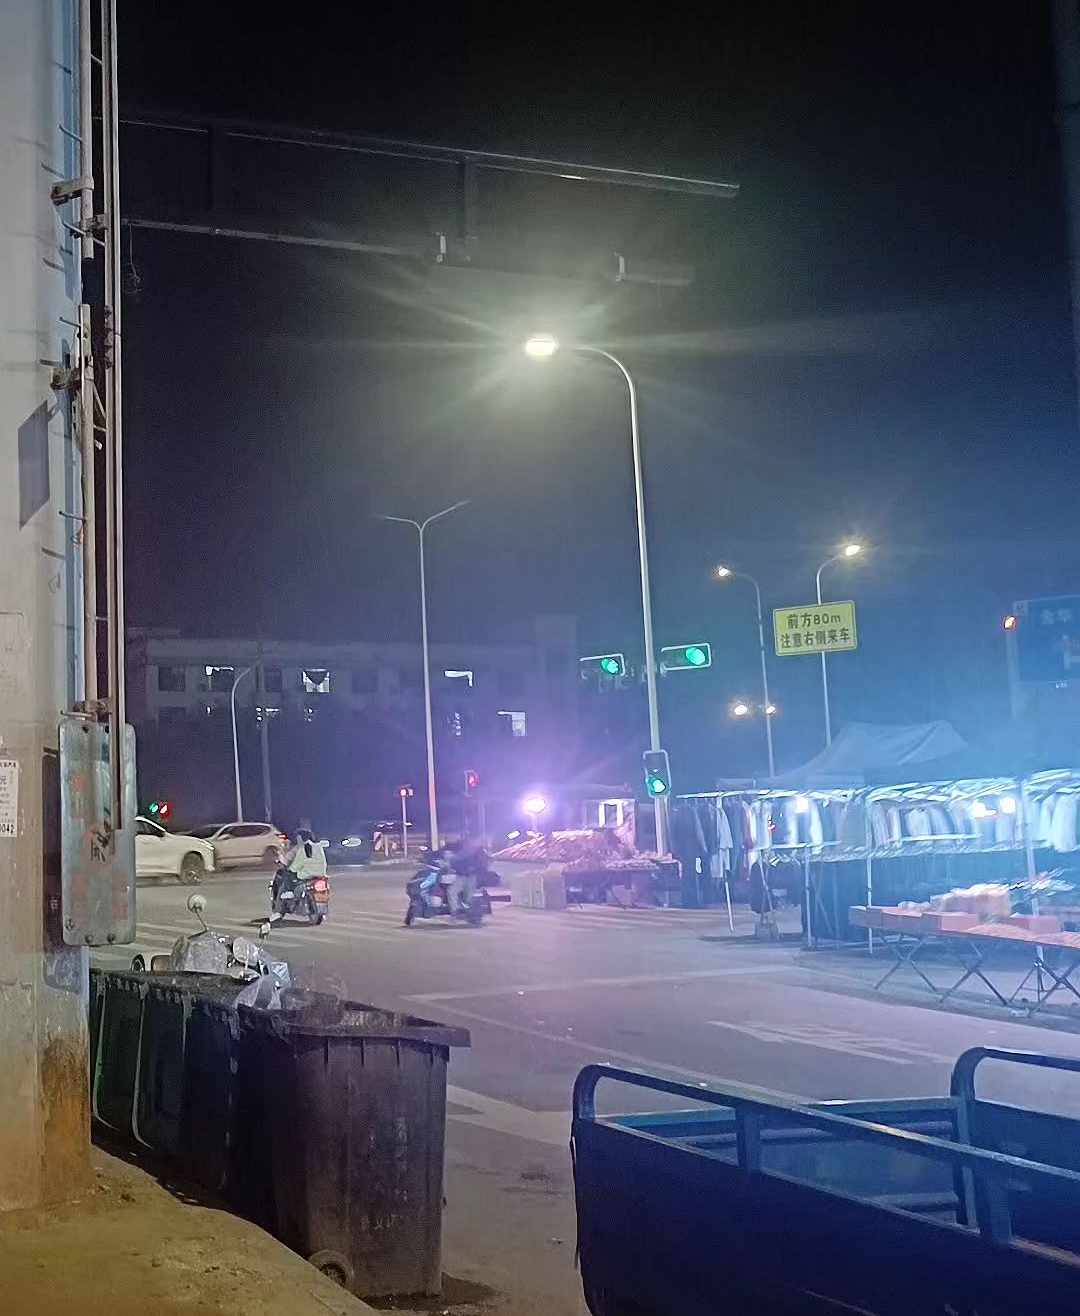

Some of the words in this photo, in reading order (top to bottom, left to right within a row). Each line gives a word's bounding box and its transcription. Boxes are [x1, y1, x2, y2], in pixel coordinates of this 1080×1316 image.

[786, 613, 841, 629] 前方80m
[781, 627, 851, 648] 注意右侧来车
